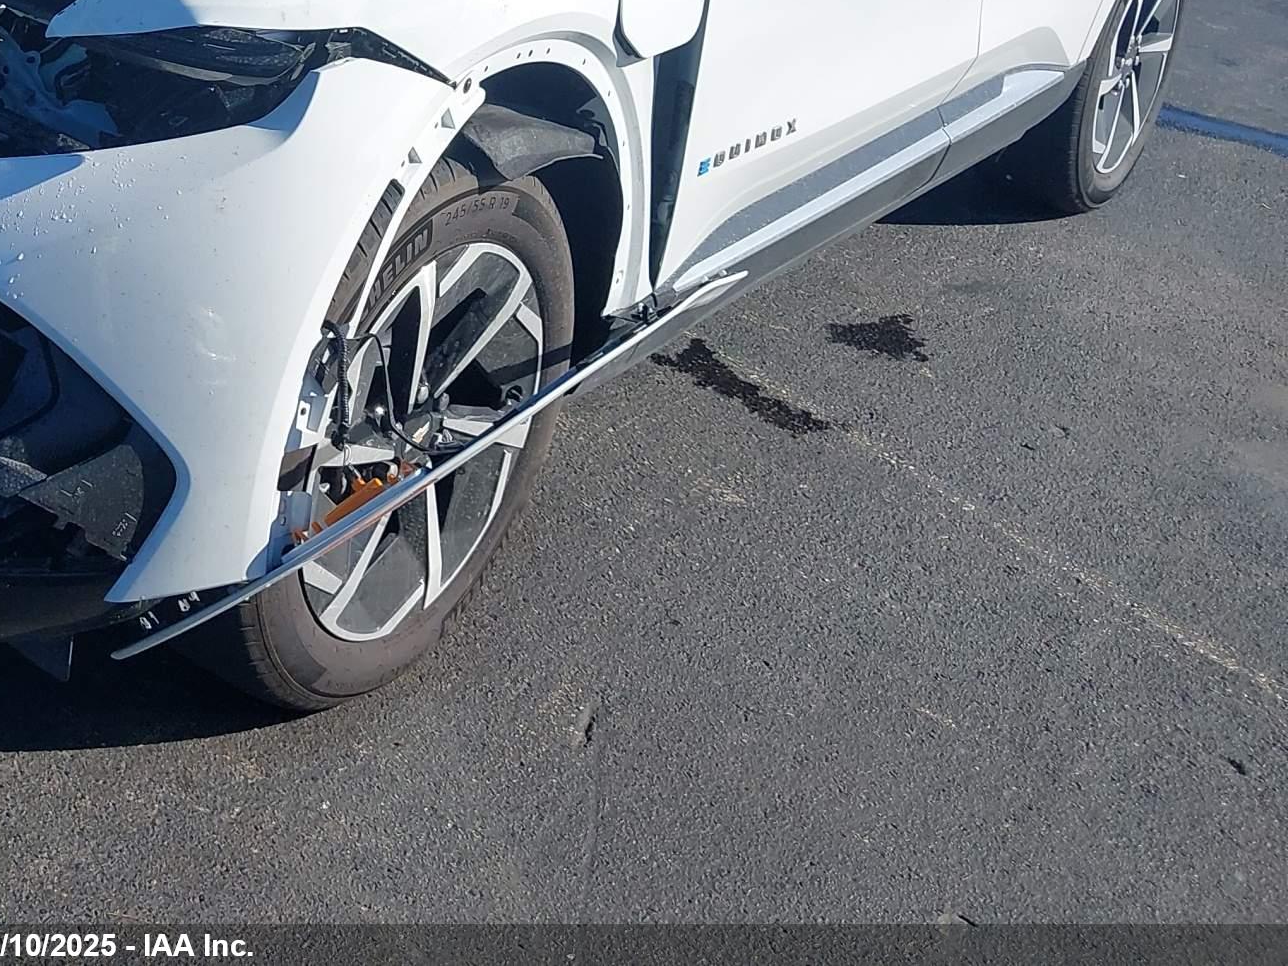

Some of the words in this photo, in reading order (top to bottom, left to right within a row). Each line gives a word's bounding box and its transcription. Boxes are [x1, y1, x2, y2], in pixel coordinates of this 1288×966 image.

[444, 198, 487, 227] 245/55
[488, 196, 497, 210] R
[499, 196, 510, 210] 19
[364, 228, 429, 314] HELIN
